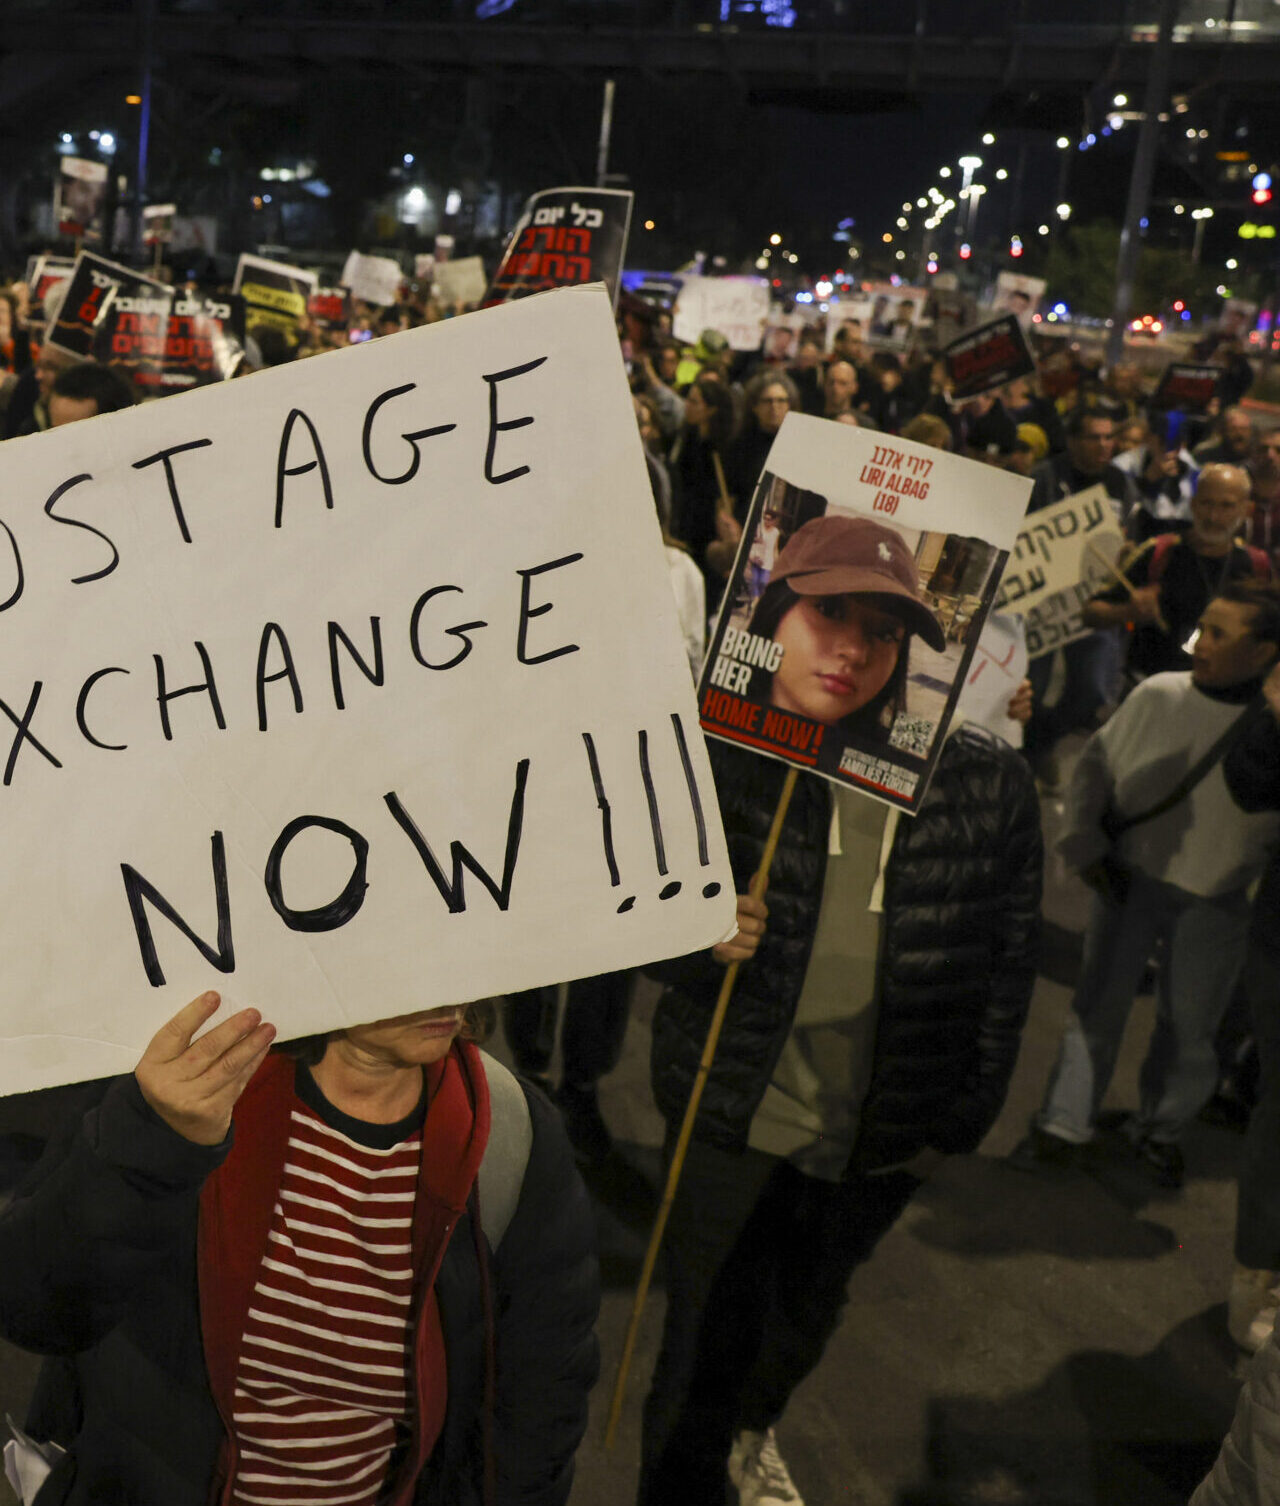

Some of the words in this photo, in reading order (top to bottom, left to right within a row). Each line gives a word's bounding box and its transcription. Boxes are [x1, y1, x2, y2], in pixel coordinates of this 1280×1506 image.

[534, 206, 566, 226] יום
[570, 202, 604, 228] כל
[520, 226, 592, 255] הורג
[204, 298, 232, 320] כל
[870, 445, 905, 471] אלבג
[906, 454, 935, 479] לירי
[859, 465, 887, 488] LIRI
[885, 472, 931, 500] ALBAG
[872, 490, 900, 516] (18)
[1014, 498, 1105, 563] עסקה
[719, 625, 785, 674] BRING
[709, 655, 753, 697] HER
[701, 688, 762, 732] HOME
[761, 709, 825, 754] NOW!
